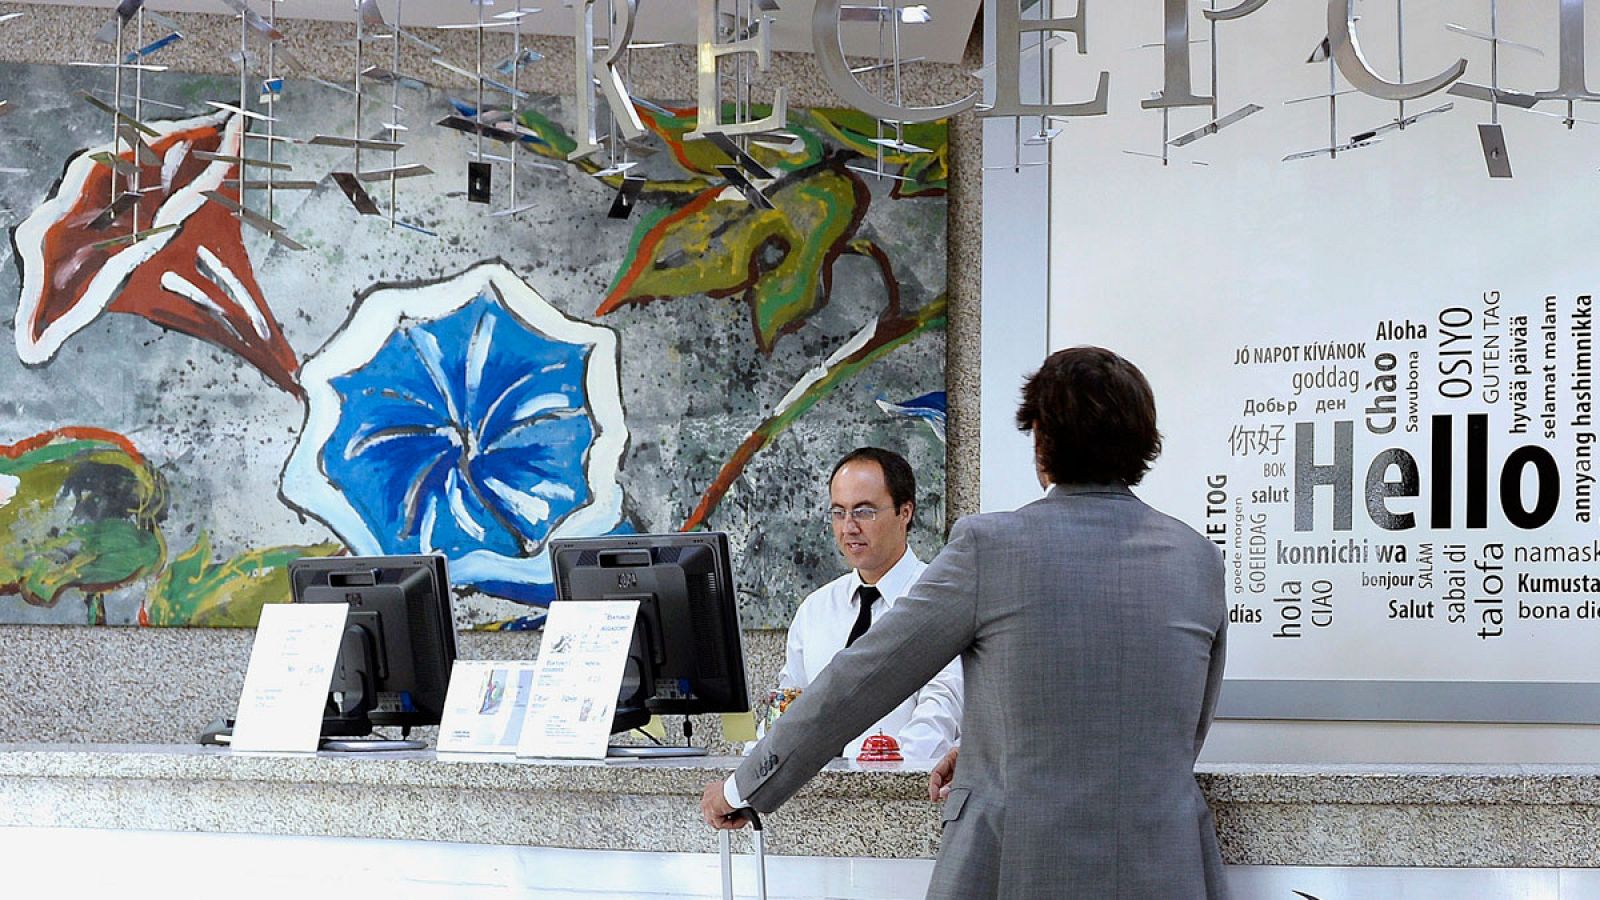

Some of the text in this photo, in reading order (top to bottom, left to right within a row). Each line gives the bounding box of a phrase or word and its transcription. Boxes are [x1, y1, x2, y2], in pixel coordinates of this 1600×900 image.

[1234, 341, 1366, 364] JÓ NAPOT KÍVÁNOK
[1376, 320, 1427, 340] Aloha
[1483, 291, 1500, 404] GUTEN TAG
[1438, 308, 1472, 398] OSIYO
[1509, 316, 1532, 433] hyvää päivää
[1540, 295, 1556, 438] selamat malam
[1293, 365, 1359, 395] goddag
[1364, 353, 1397, 434] Chào
[1406, 352, 1419, 432] Sawubona
[1316, 399, 1345, 414] ден
[1571, 295, 1596, 523] annyang hashimnikka
[1228, 424, 1286, 456] 你好
[1264, 462, 1286, 477] BOK
[1294, 413, 1561, 530] Hello
[1207, 475, 1227, 518] TOG
[1252, 486, 1289, 503] salut
[1232, 497, 1245, 594] goede morgen
[1249, 513, 1267, 593] GOEIEDAG
[1277, 539, 1406, 564] konnichi wa
[1312, 580, 1332, 627] CIAO
[1362, 572, 1414, 590] bonjour
[1442, 545, 1466, 623] sabai di
[1474, 544, 1504, 640] talofa
[1519, 573, 1600, 592] Kumusta
[1229, 604, 1262, 623] días
[1273, 580, 1301, 637] hola
[1389, 599, 1434, 618] Salut
[1519, 600, 1569, 619] bona
